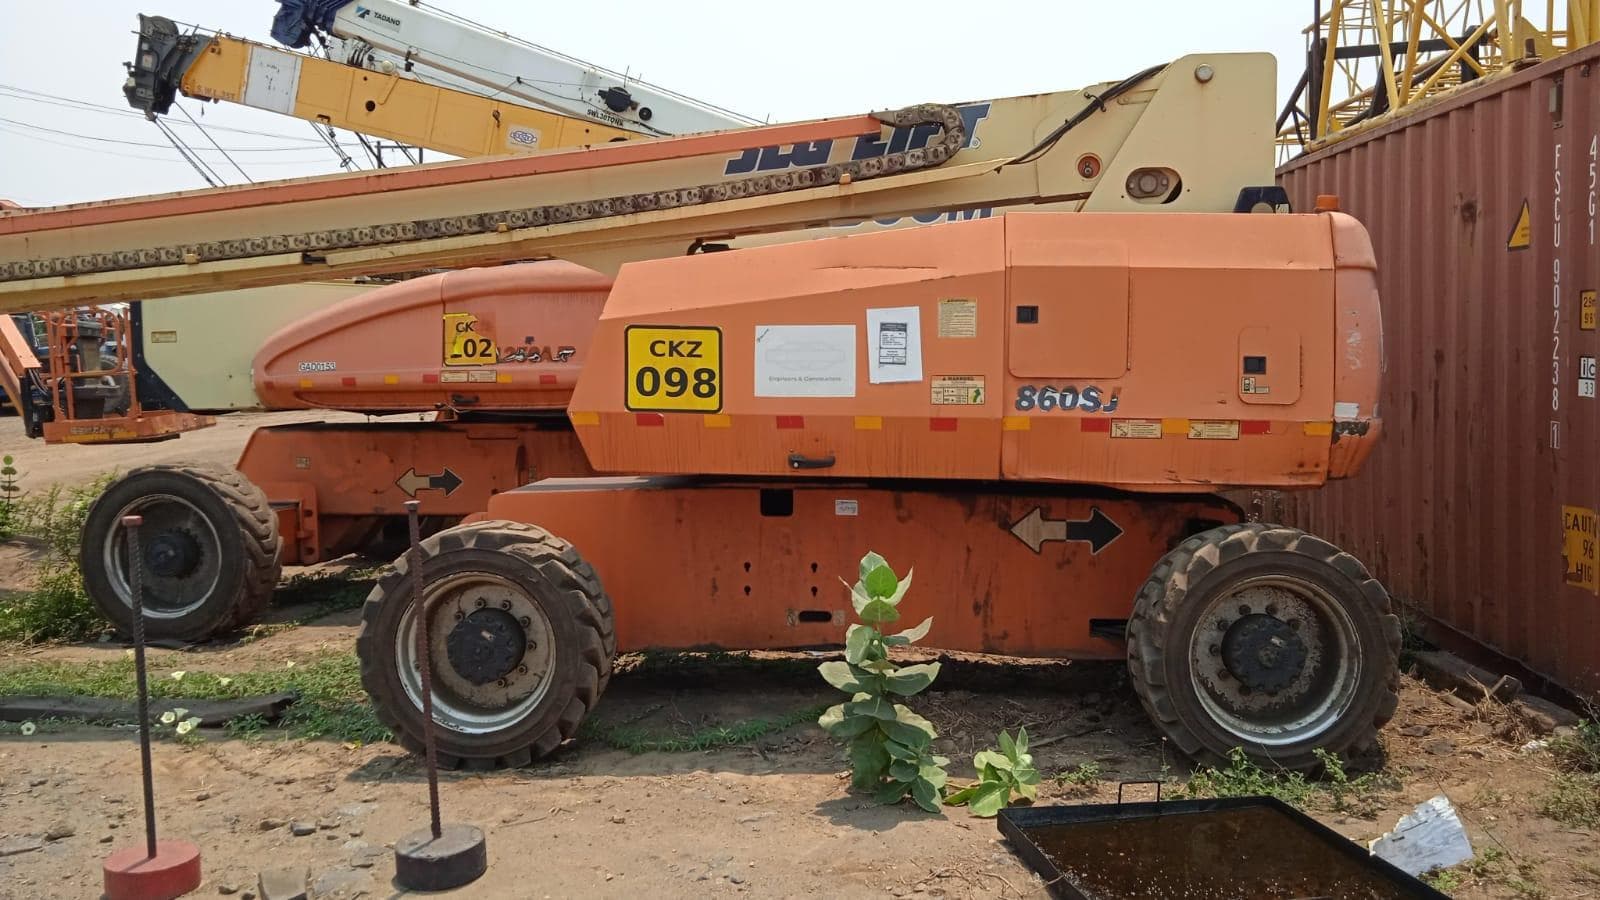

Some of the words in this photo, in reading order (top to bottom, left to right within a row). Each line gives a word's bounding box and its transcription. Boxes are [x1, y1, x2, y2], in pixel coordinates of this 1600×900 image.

[374, 11, 401, 26] TADANO
[1553, 143, 1562, 248] FSCU
[1588, 134, 1598, 246] 45G1
[450, 338, 493, 359] 02
[649, 340, 703, 358] CKZ
[635, 366, 717, 399] 098
[1014, 384, 1122, 413] 860SJ
